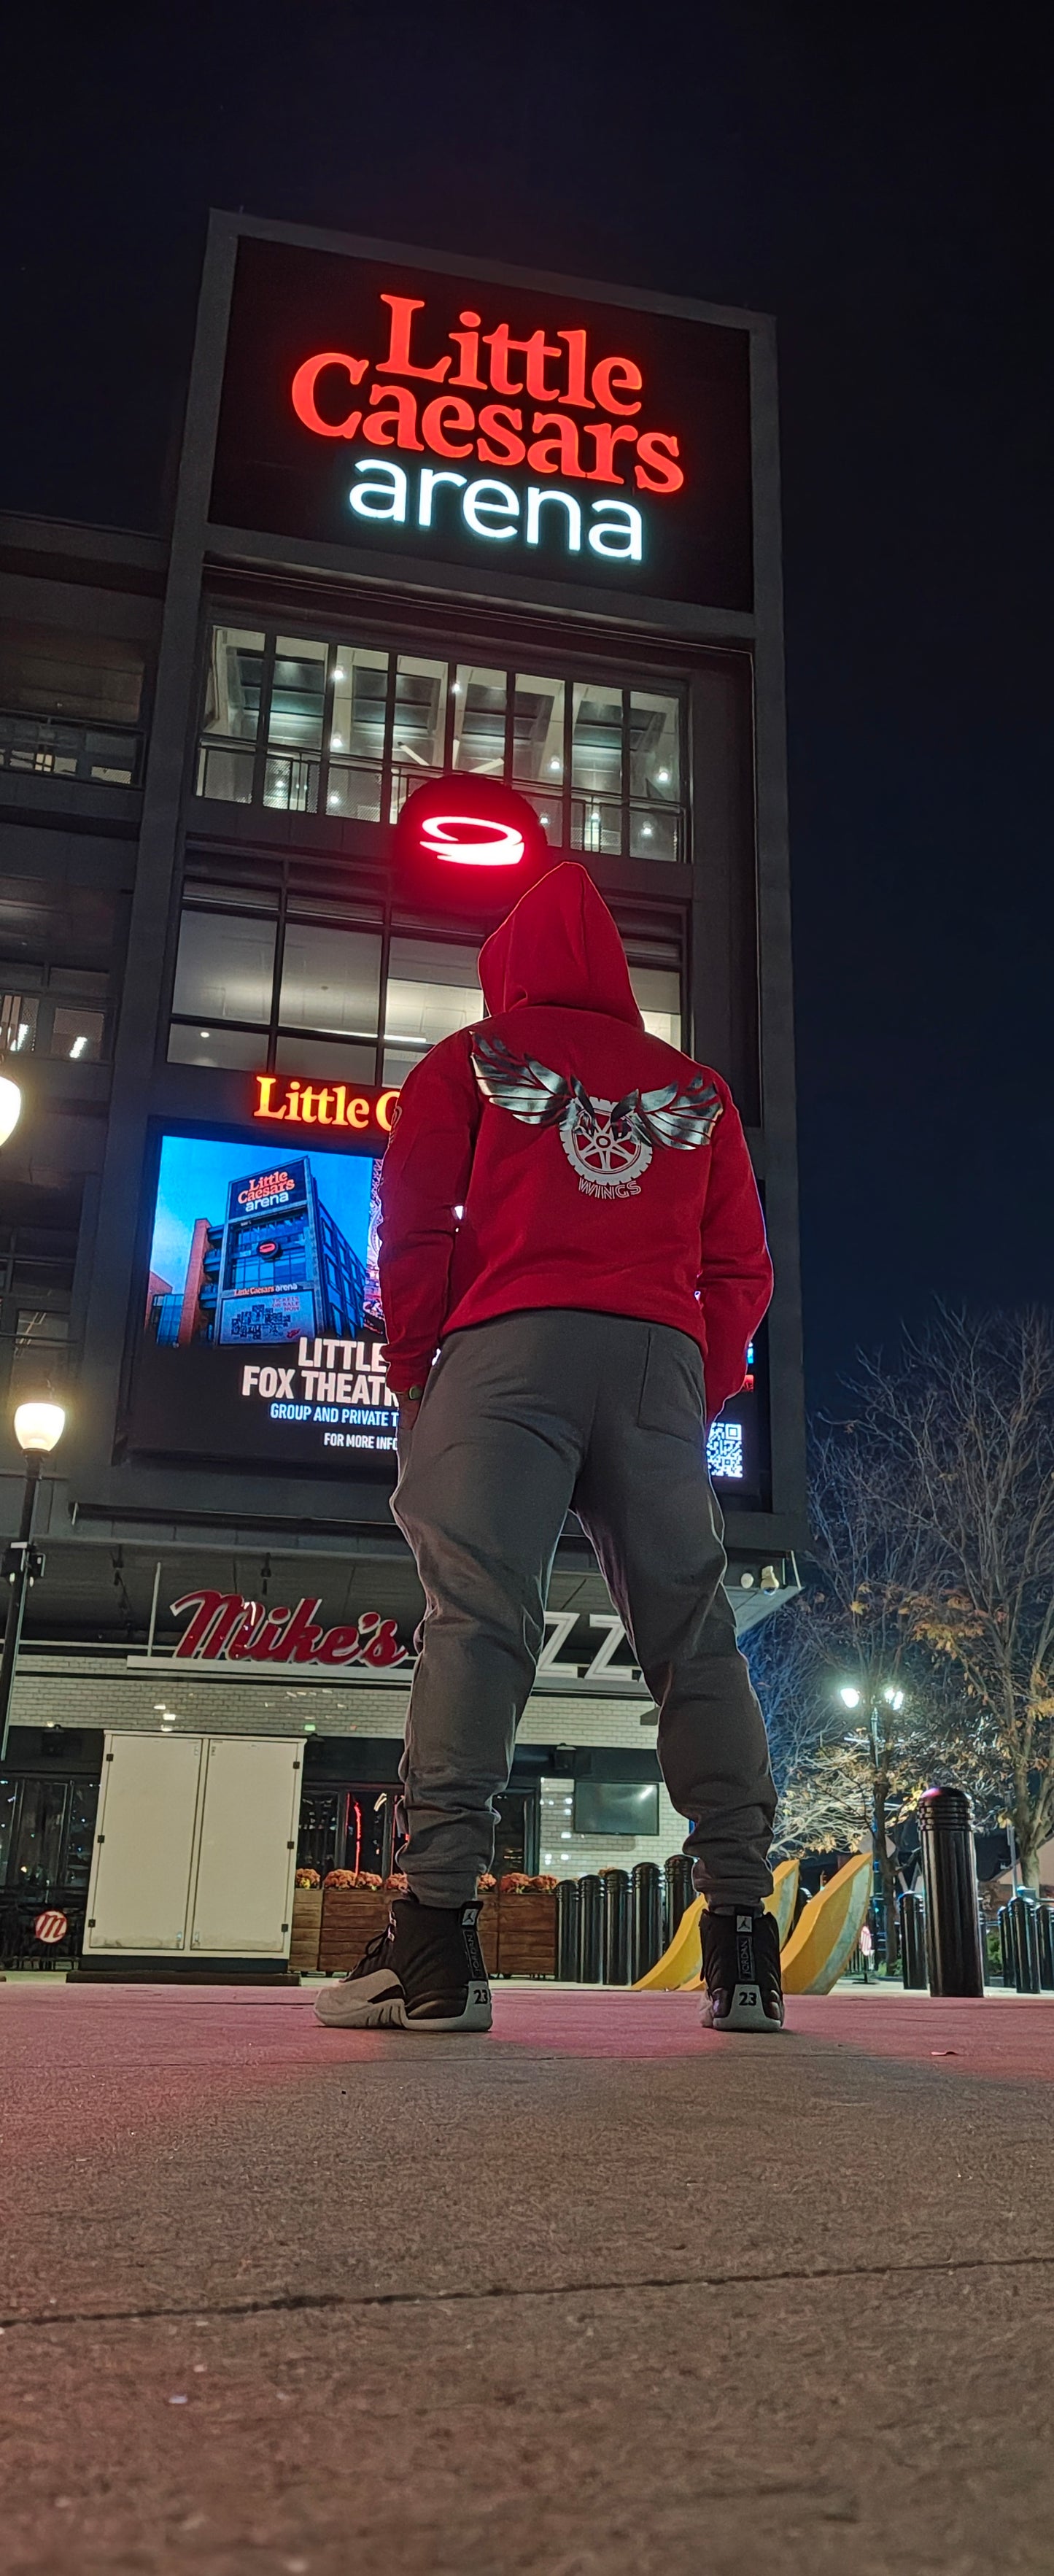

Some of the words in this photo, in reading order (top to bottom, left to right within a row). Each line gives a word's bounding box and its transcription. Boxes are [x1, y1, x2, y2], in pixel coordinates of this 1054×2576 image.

[376, 293, 643, 416] Little
[292, 352, 684, 493] Caesars
[349, 458, 643, 561] arena
[254, 1075, 370, 1129] Little
[238, 1179, 295, 1204] Caesars
[249, 1171, 288, 1192] Little
[578, 1177, 642, 1200] WINGS
[245, 1191, 290, 1212] arena
[275, 1283, 298, 1292] arena
[298, 1337, 389, 1372] LITTLE
[241, 1365, 295, 1400] FOX
[270, 1403, 312, 1420] GROUP
[313, 1407, 339, 1423] AND
[341, 1409, 389, 1427] PRIVATE
[323, 1432, 344, 1447] FOR
[346, 1434, 375, 1449] MORE
[169, 1589, 408, 1668] Mike's
[473, 1989, 488, 2005] 23
[738, 1991, 757, 2006] 23
